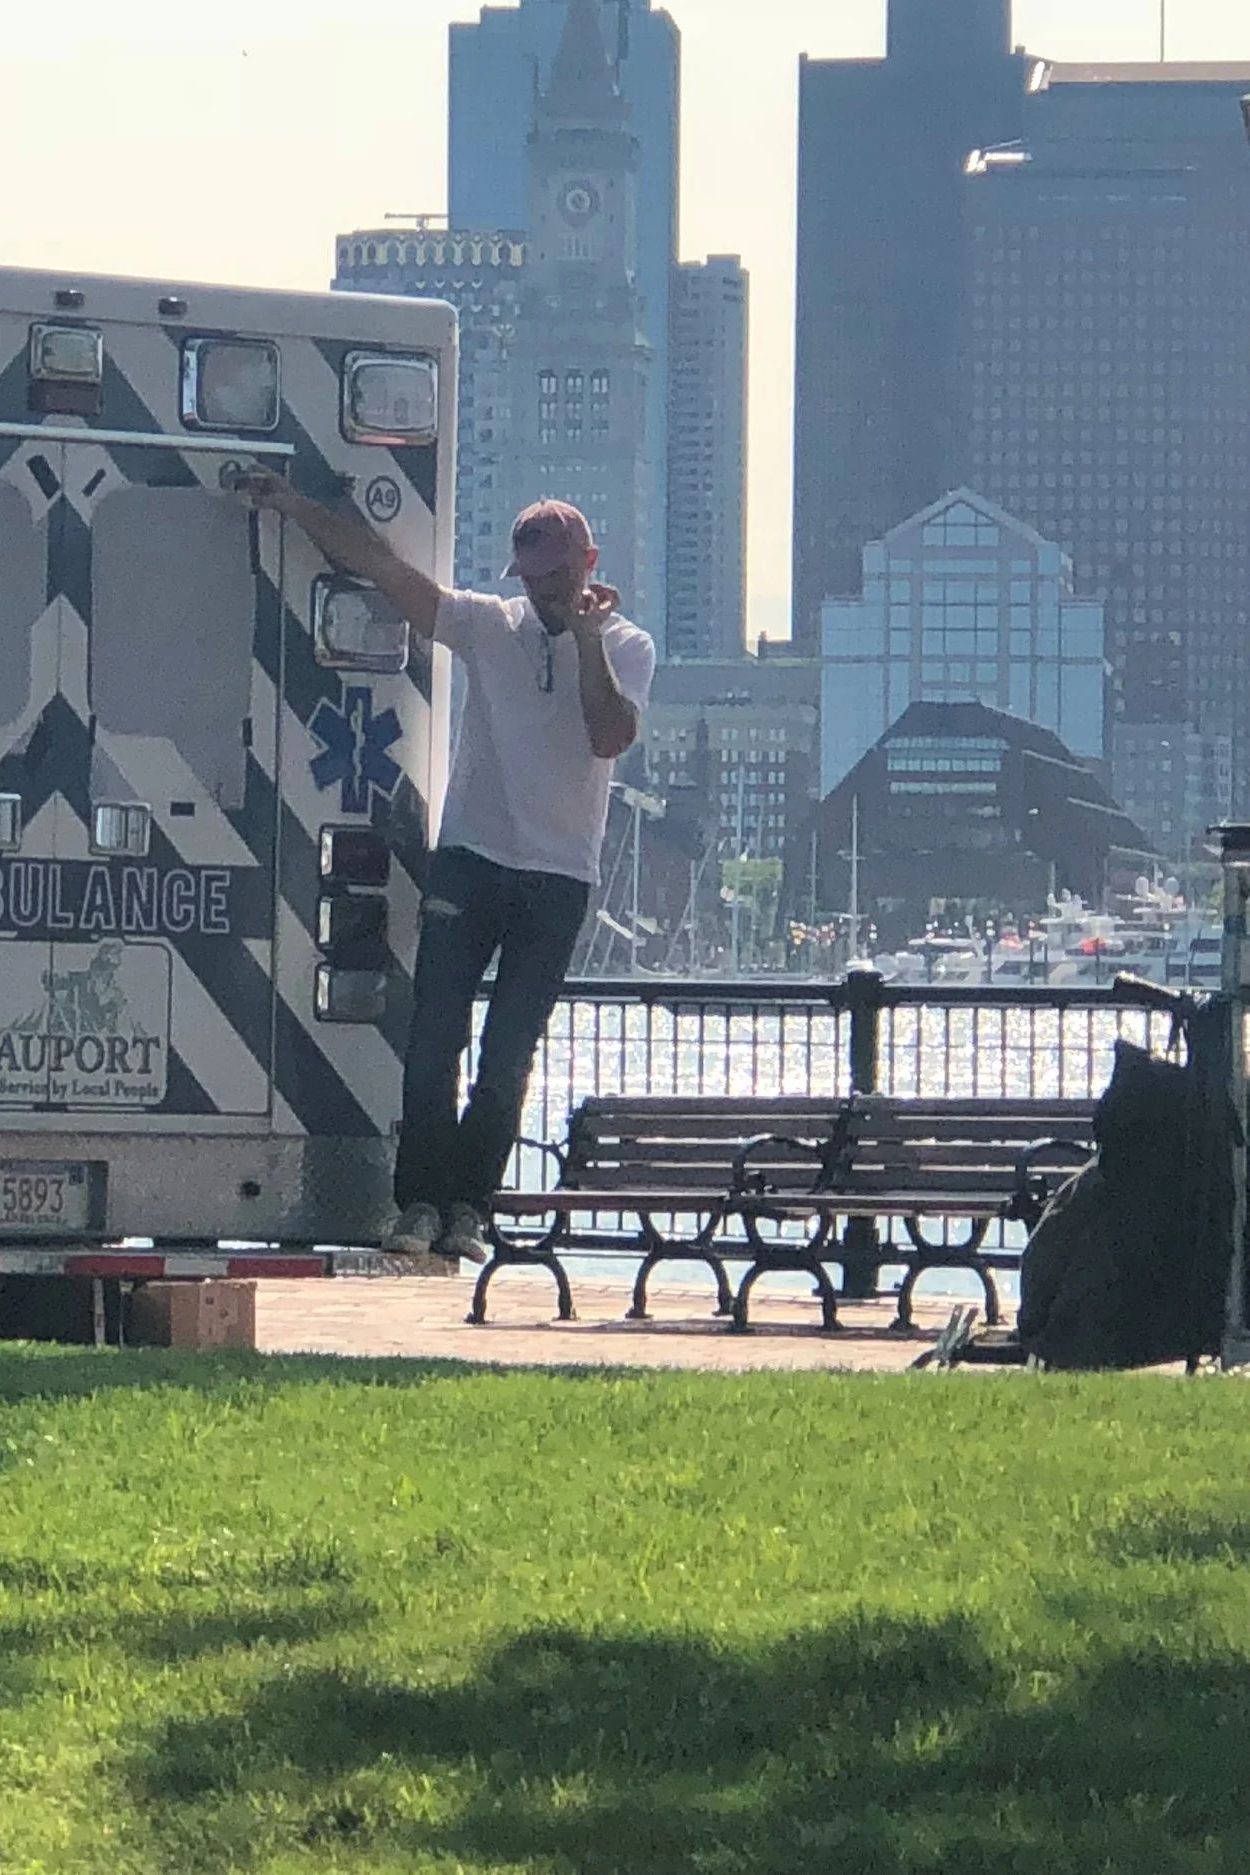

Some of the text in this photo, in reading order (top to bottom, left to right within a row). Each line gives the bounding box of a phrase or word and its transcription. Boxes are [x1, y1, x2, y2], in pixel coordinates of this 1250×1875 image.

[370, 486, 396, 508] A9
[52, 1079, 67, 1099] by
[72, 1078, 110, 1097] Local
[115, 1080, 159, 1102] People
[3, 1178, 64, 1213] 5893
